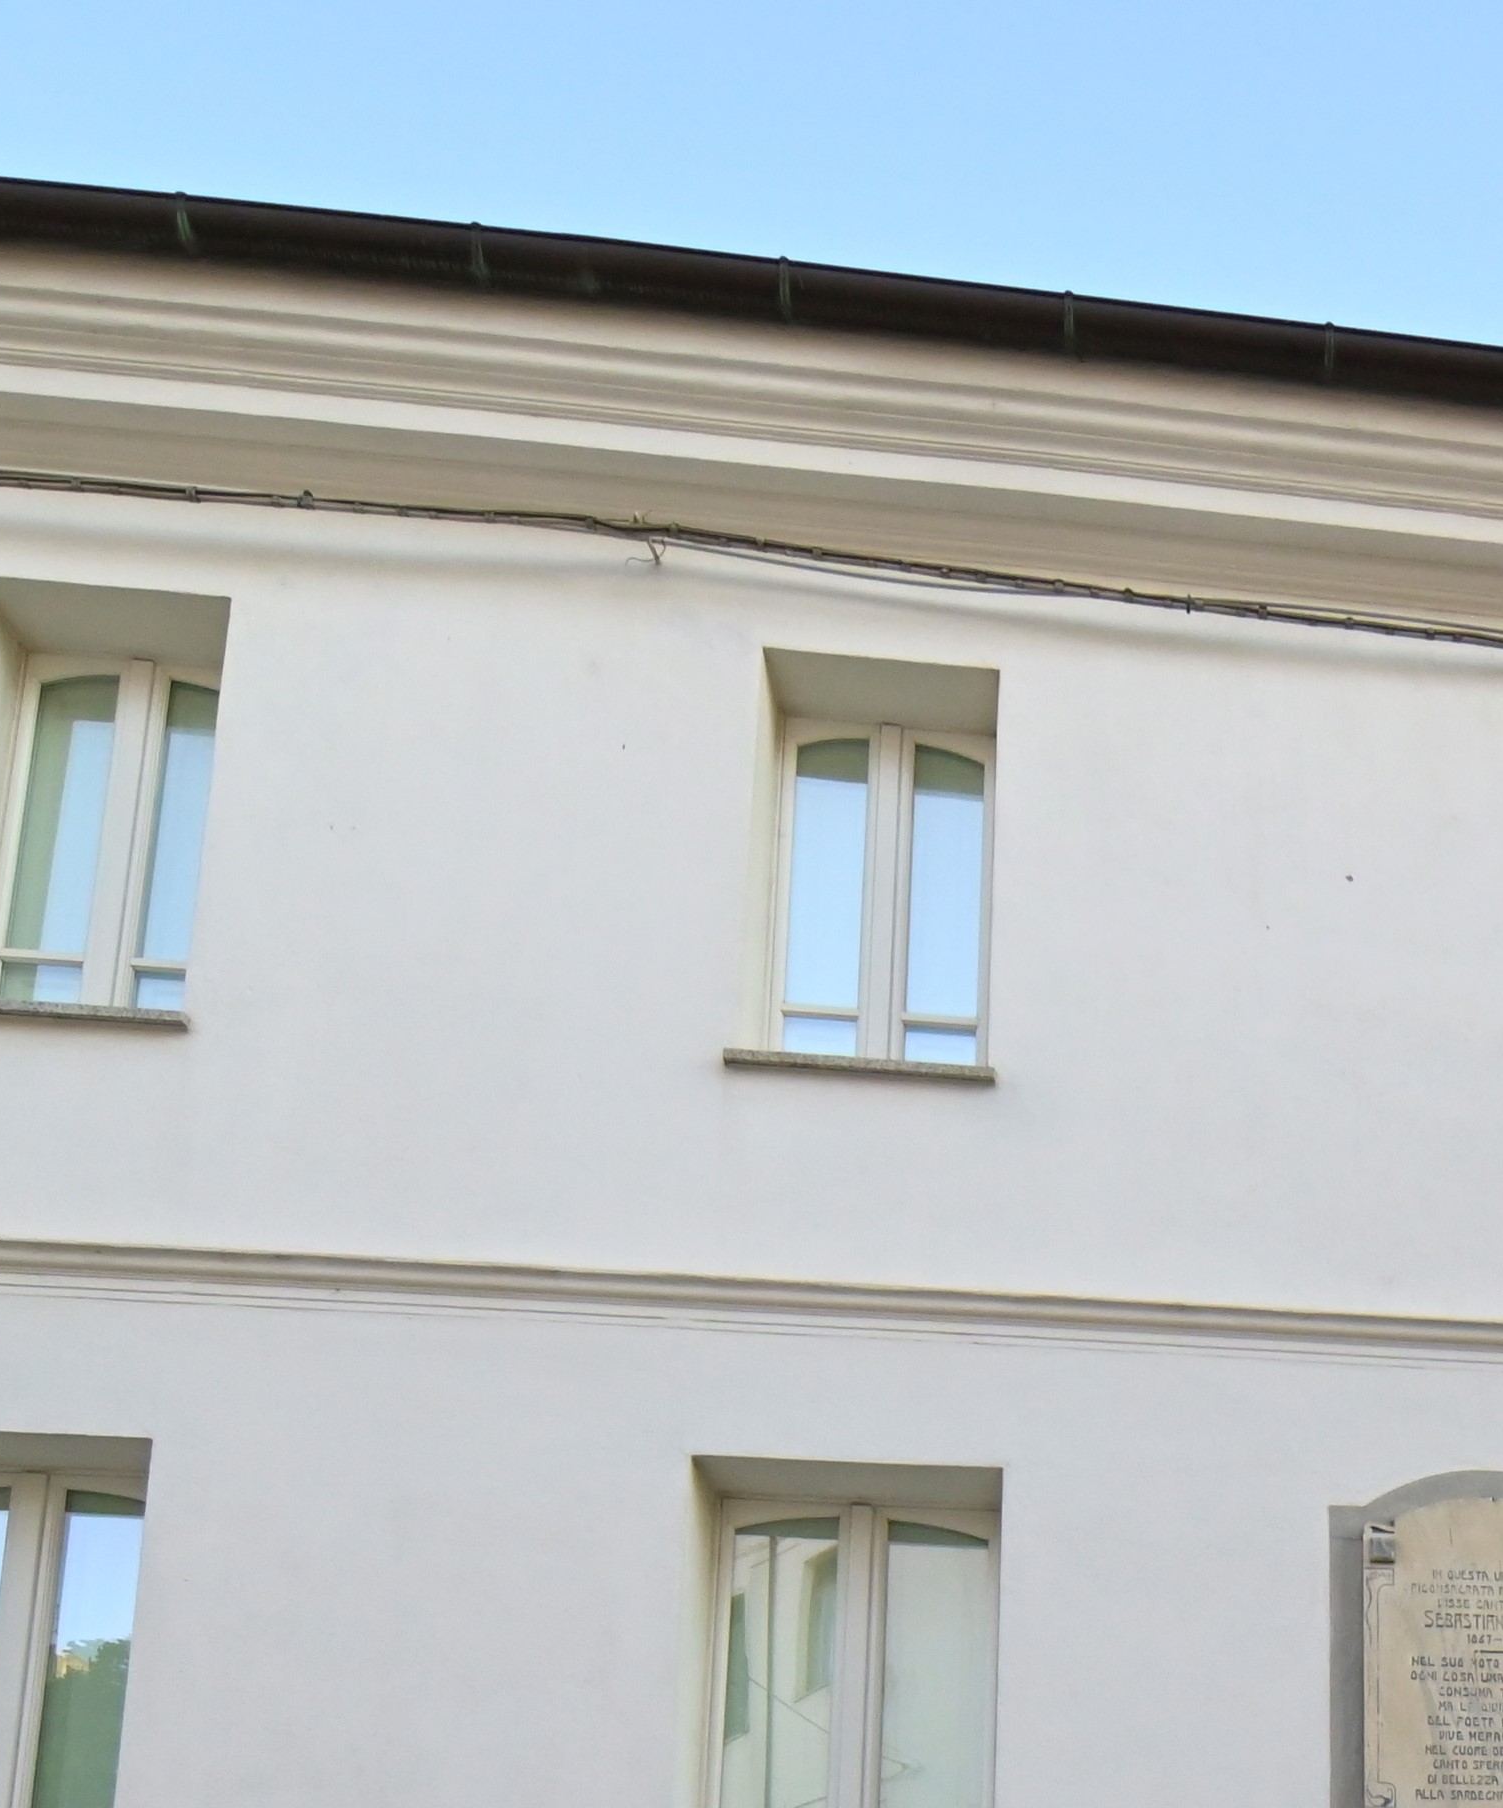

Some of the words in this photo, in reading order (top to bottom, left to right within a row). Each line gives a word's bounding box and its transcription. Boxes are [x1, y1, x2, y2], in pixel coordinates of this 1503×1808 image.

[1447, 1570, 1489, 1581] QUESTA
[1411, 1656, 1435, 1667] NEL
[1440, 1657, 1464, 1667] SUO
[1411, 1670, 1437, 1681] OGNI
[1443, 1671, 1475, 1683] COSA
[1439, 1686, 1493, 1698] CONSUMA
[1438, 1701, 1453, 1711] MA
[1427, 1715, 1450, 1727] DEL
[1455, 1715, 1495, 1728] POETA
[1425, 1744, 1446, 1756] NEL
[1452, 1745, 1488, 1756] CUORE
[1433, 1759, 1468, 1771] CANTO
[1427, 1774, 1437, 1785] DI
[1441, 1774, 1499, 1786] BELLEZZA
[1415, 1788, 1445, 1801] ALLA
